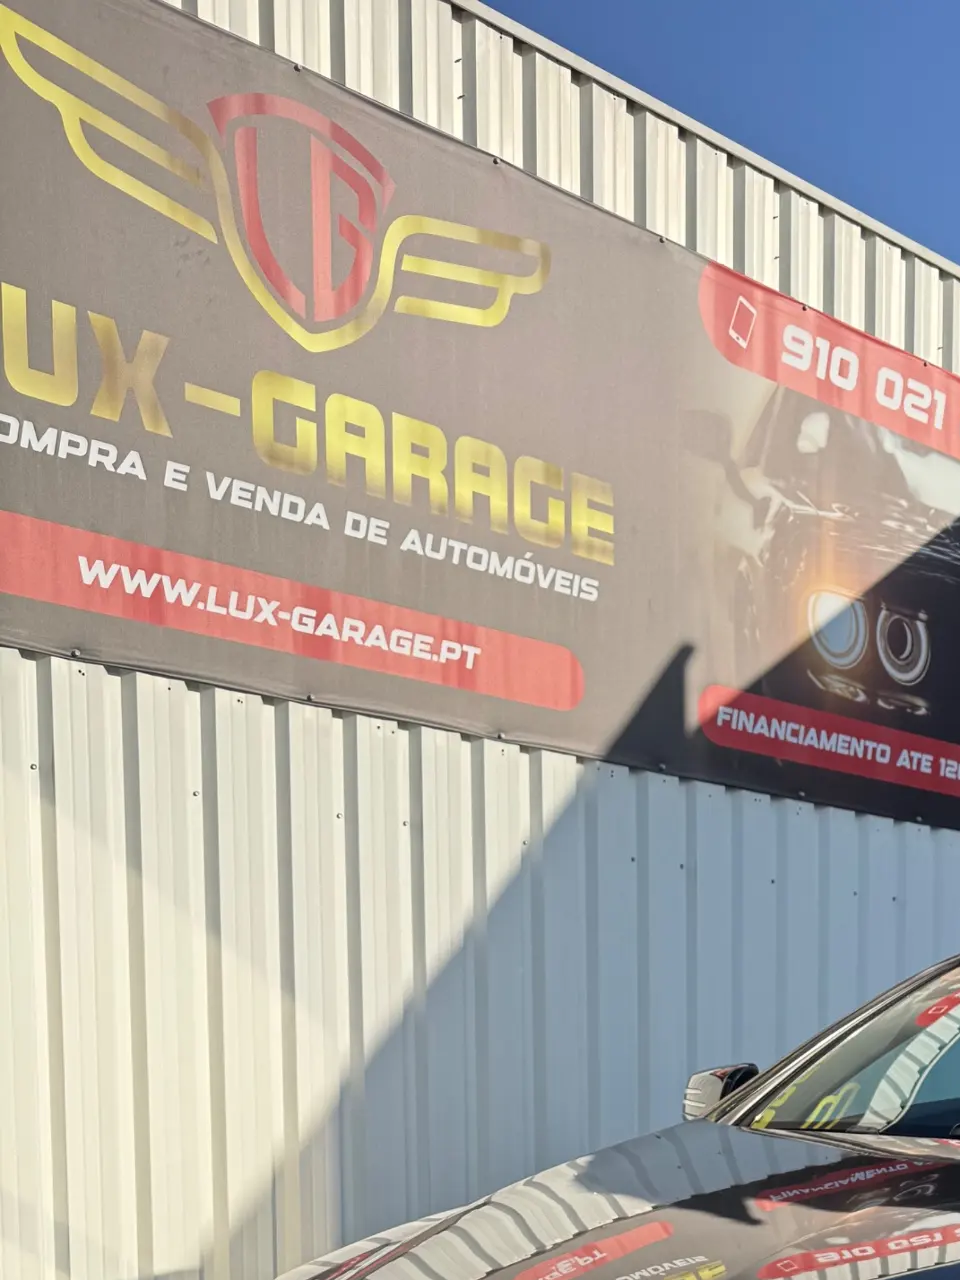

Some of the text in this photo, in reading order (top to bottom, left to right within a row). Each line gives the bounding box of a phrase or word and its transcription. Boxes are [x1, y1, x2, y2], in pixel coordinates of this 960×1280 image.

[0, 281, 614, 566] UX-GARAGE
[781, 324, 859, 392] 910
[876, 366, 946, 430] 021
[0, 412, 599, 602] OMPRA E VENDA DE AUTOMÓVEIS
[77, 556, 482, 671] WWW.LUX-GARAGE.PT
[716, 706, 891, 765] FINANCIAMENTO
[896, 748, 932, 776] ATE
